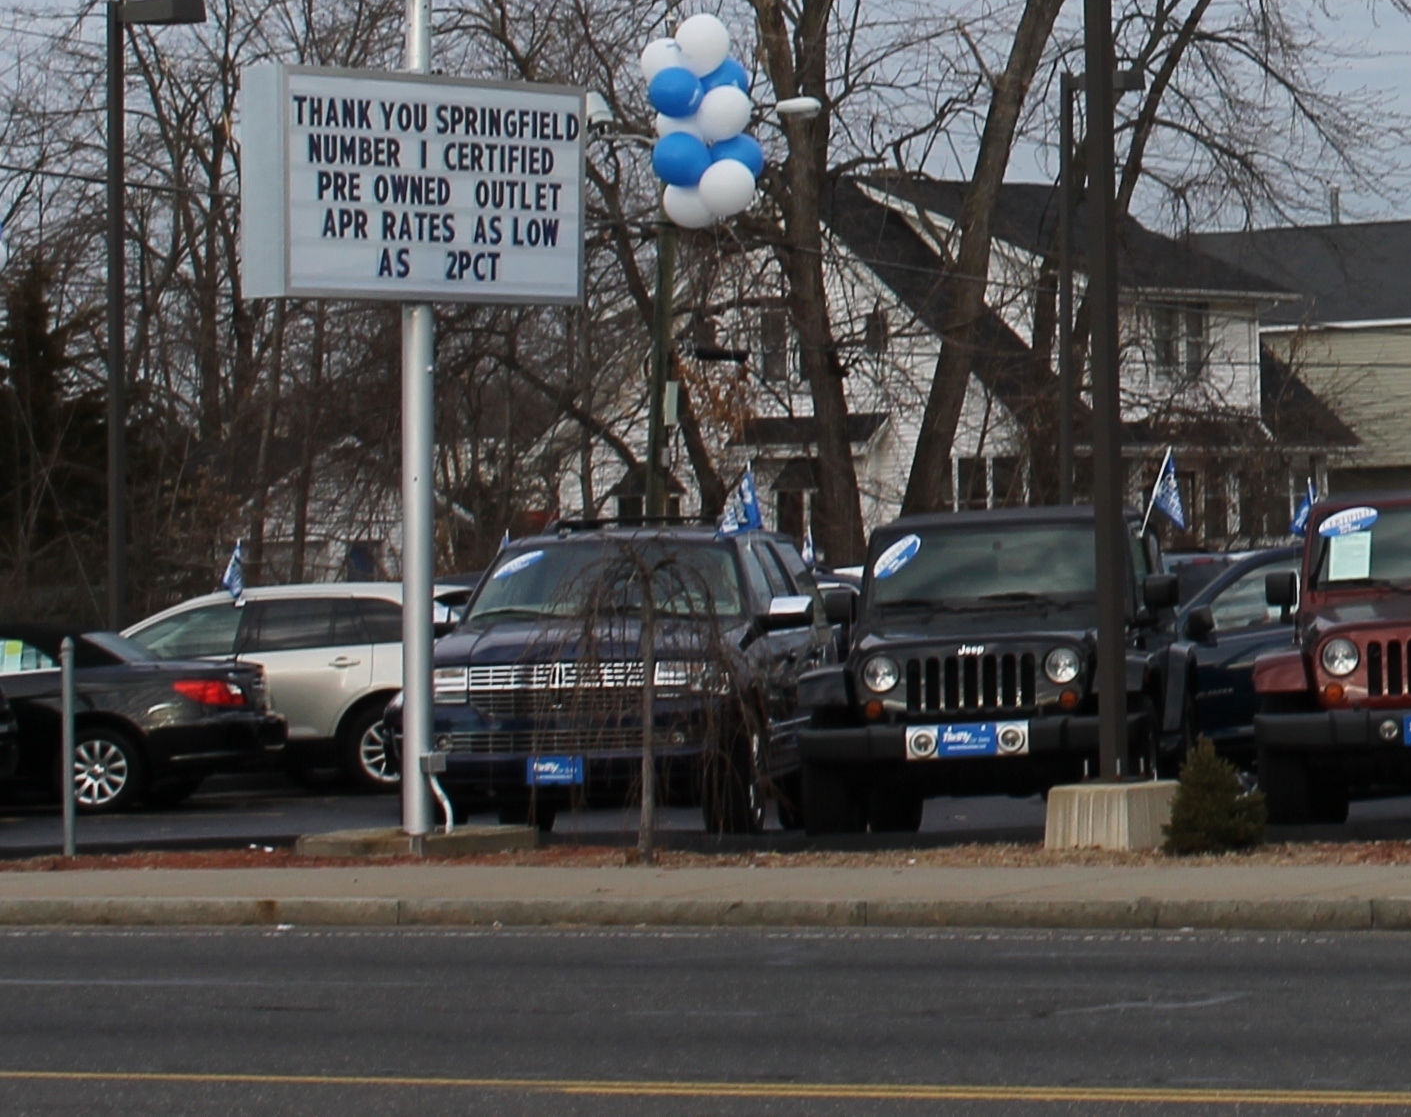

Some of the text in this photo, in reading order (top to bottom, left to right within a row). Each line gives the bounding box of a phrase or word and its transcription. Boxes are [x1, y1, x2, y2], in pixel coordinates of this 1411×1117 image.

[293, 95, 580, 141] THANK YOU SPRINGFIELD
[308, 134, 401, 168] NUMBER
[444, 142, 555, 175] CERTIFIED
[317, 171, 562, 212] PRE OWNED OUTLET
[322, 208, 560, 248] APR RATES AS LOW
[378, 248, 501, 281] AS 2PCT
[957, 643, 984, 655] Jeep
